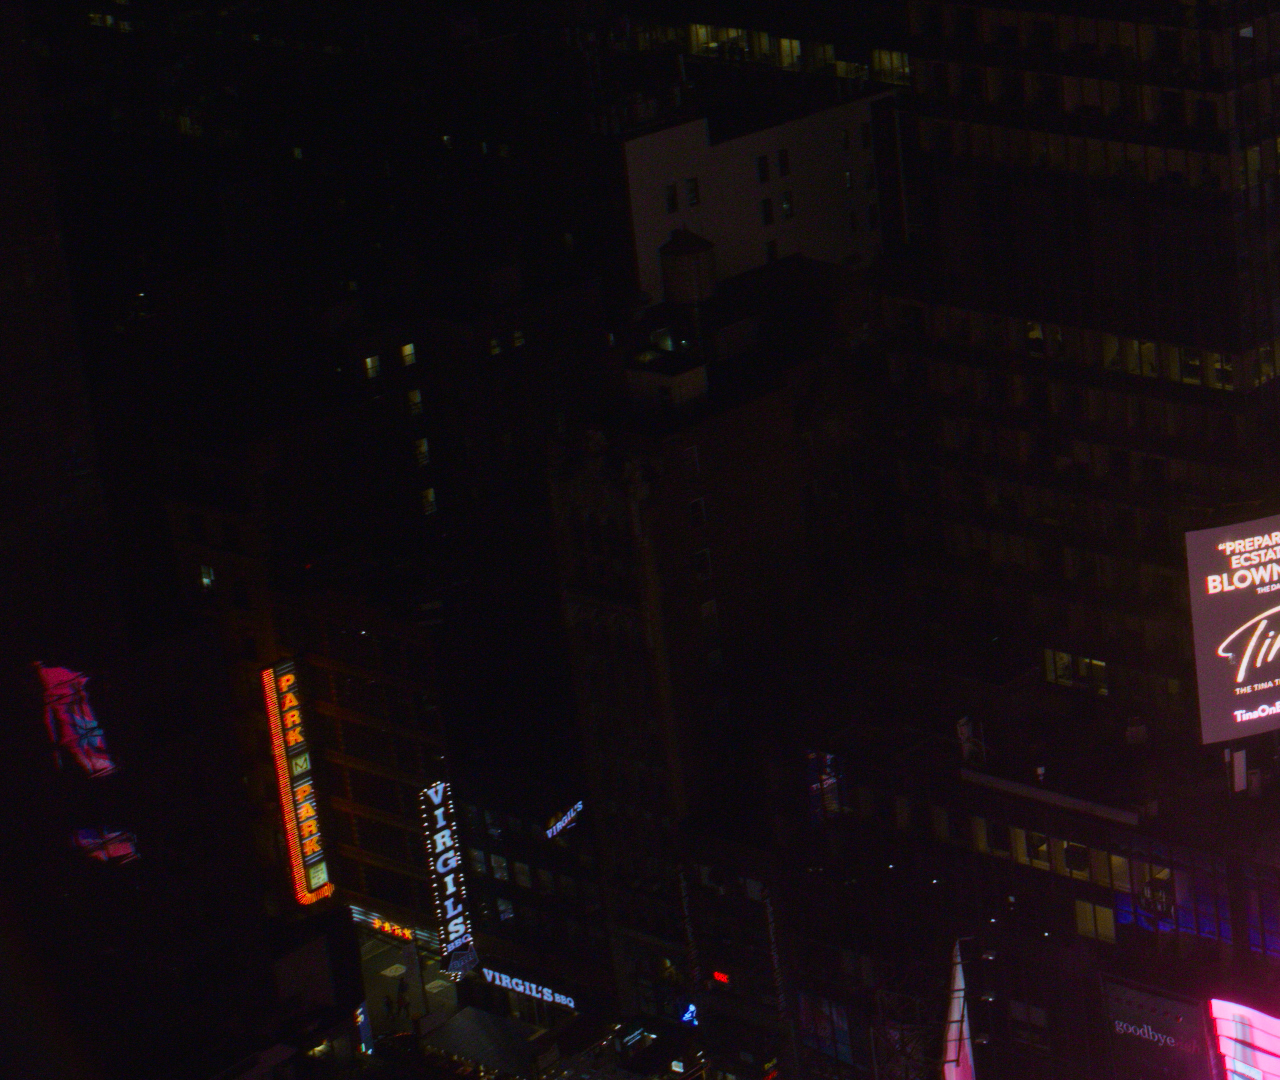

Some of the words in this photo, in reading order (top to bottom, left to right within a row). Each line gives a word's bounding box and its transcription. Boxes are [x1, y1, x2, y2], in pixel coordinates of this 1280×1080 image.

[1256, 584, 1270, 594] THE
[1235, 684, 1252, 695] THE
[1253, 680, 1273, 692] TINA
[277, 673, 304, 747] PARK
[295, 783, 322, 856] PARK
[372, 918, 413, 940] PARK
[446, 933, 472, 953] BBQ
[482, 968, 553, 1002] VIRGIL'S
[554, 992, 575, 1008] BBQ
[1114, 1020, 1176, 1047] goodbye
